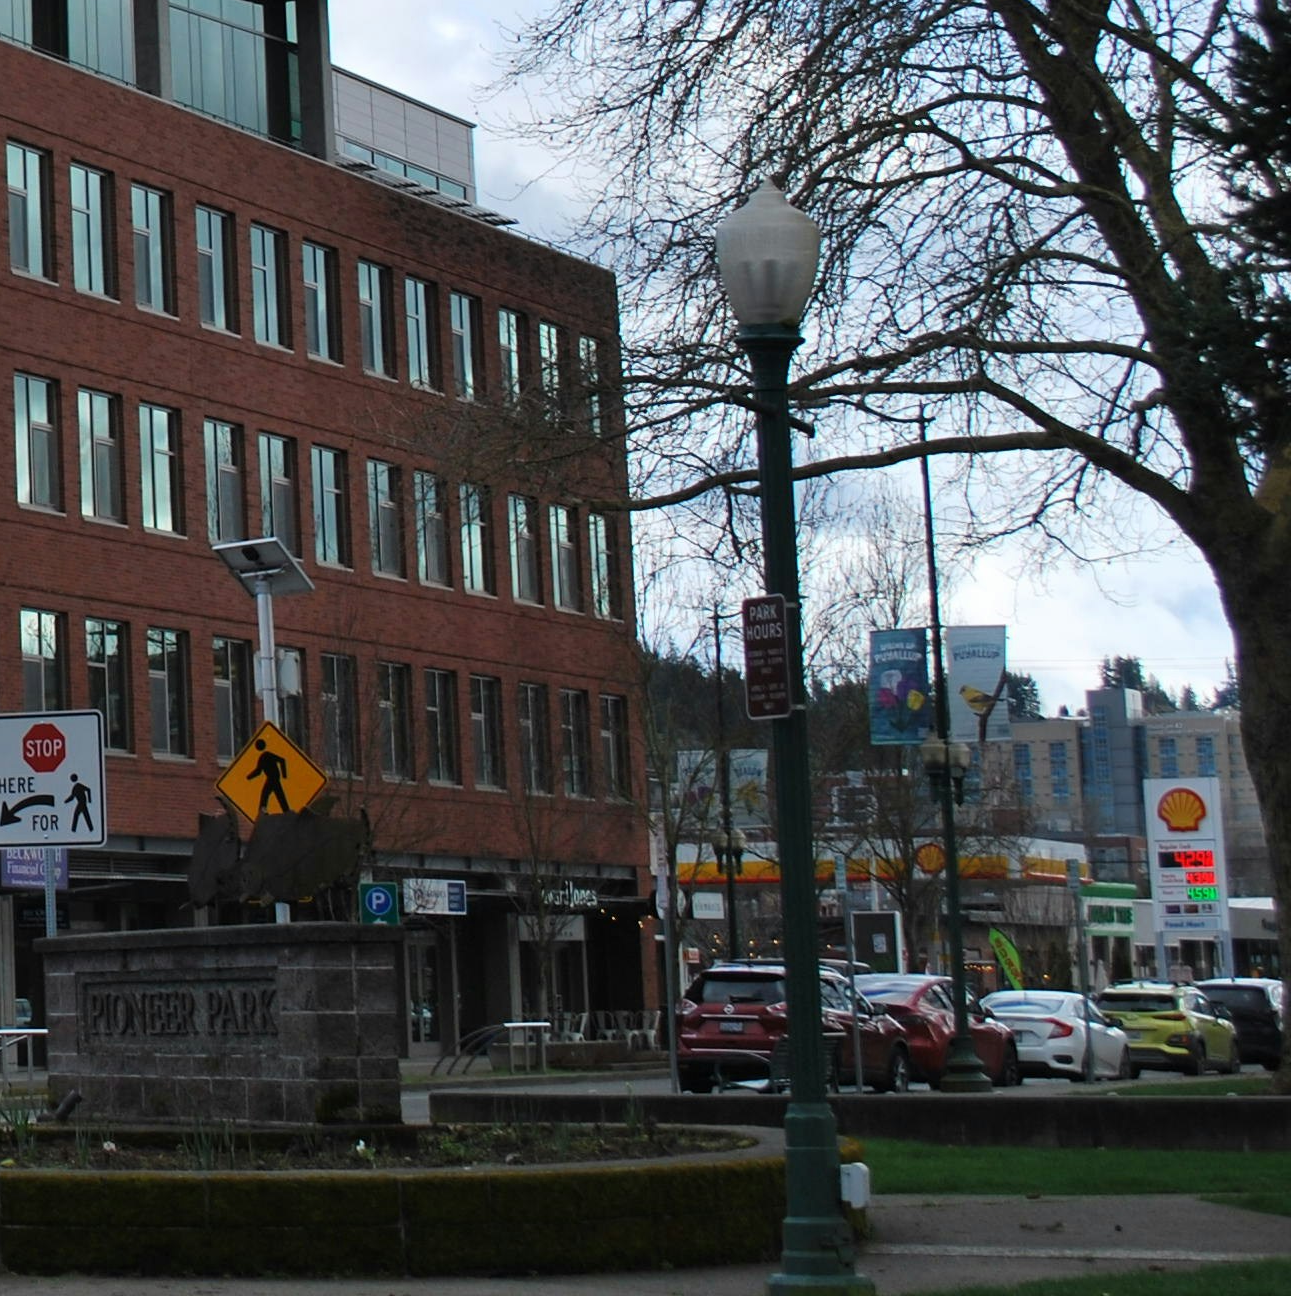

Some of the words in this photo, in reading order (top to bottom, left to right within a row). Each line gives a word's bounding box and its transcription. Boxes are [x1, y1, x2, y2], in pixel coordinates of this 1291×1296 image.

[749, 605, 778, 622] PARK
[746, 622, 783, 641] HOURS
[26, 738, 63, 758] STOP
[32, 814, 59, 831] FOR
[6, 847, 62, 863] BECKWOH
[372, 892, 386, 910] P
[91, 990, 200, 1036] PIONEER
[207, 989, 279, 1036] PARK
